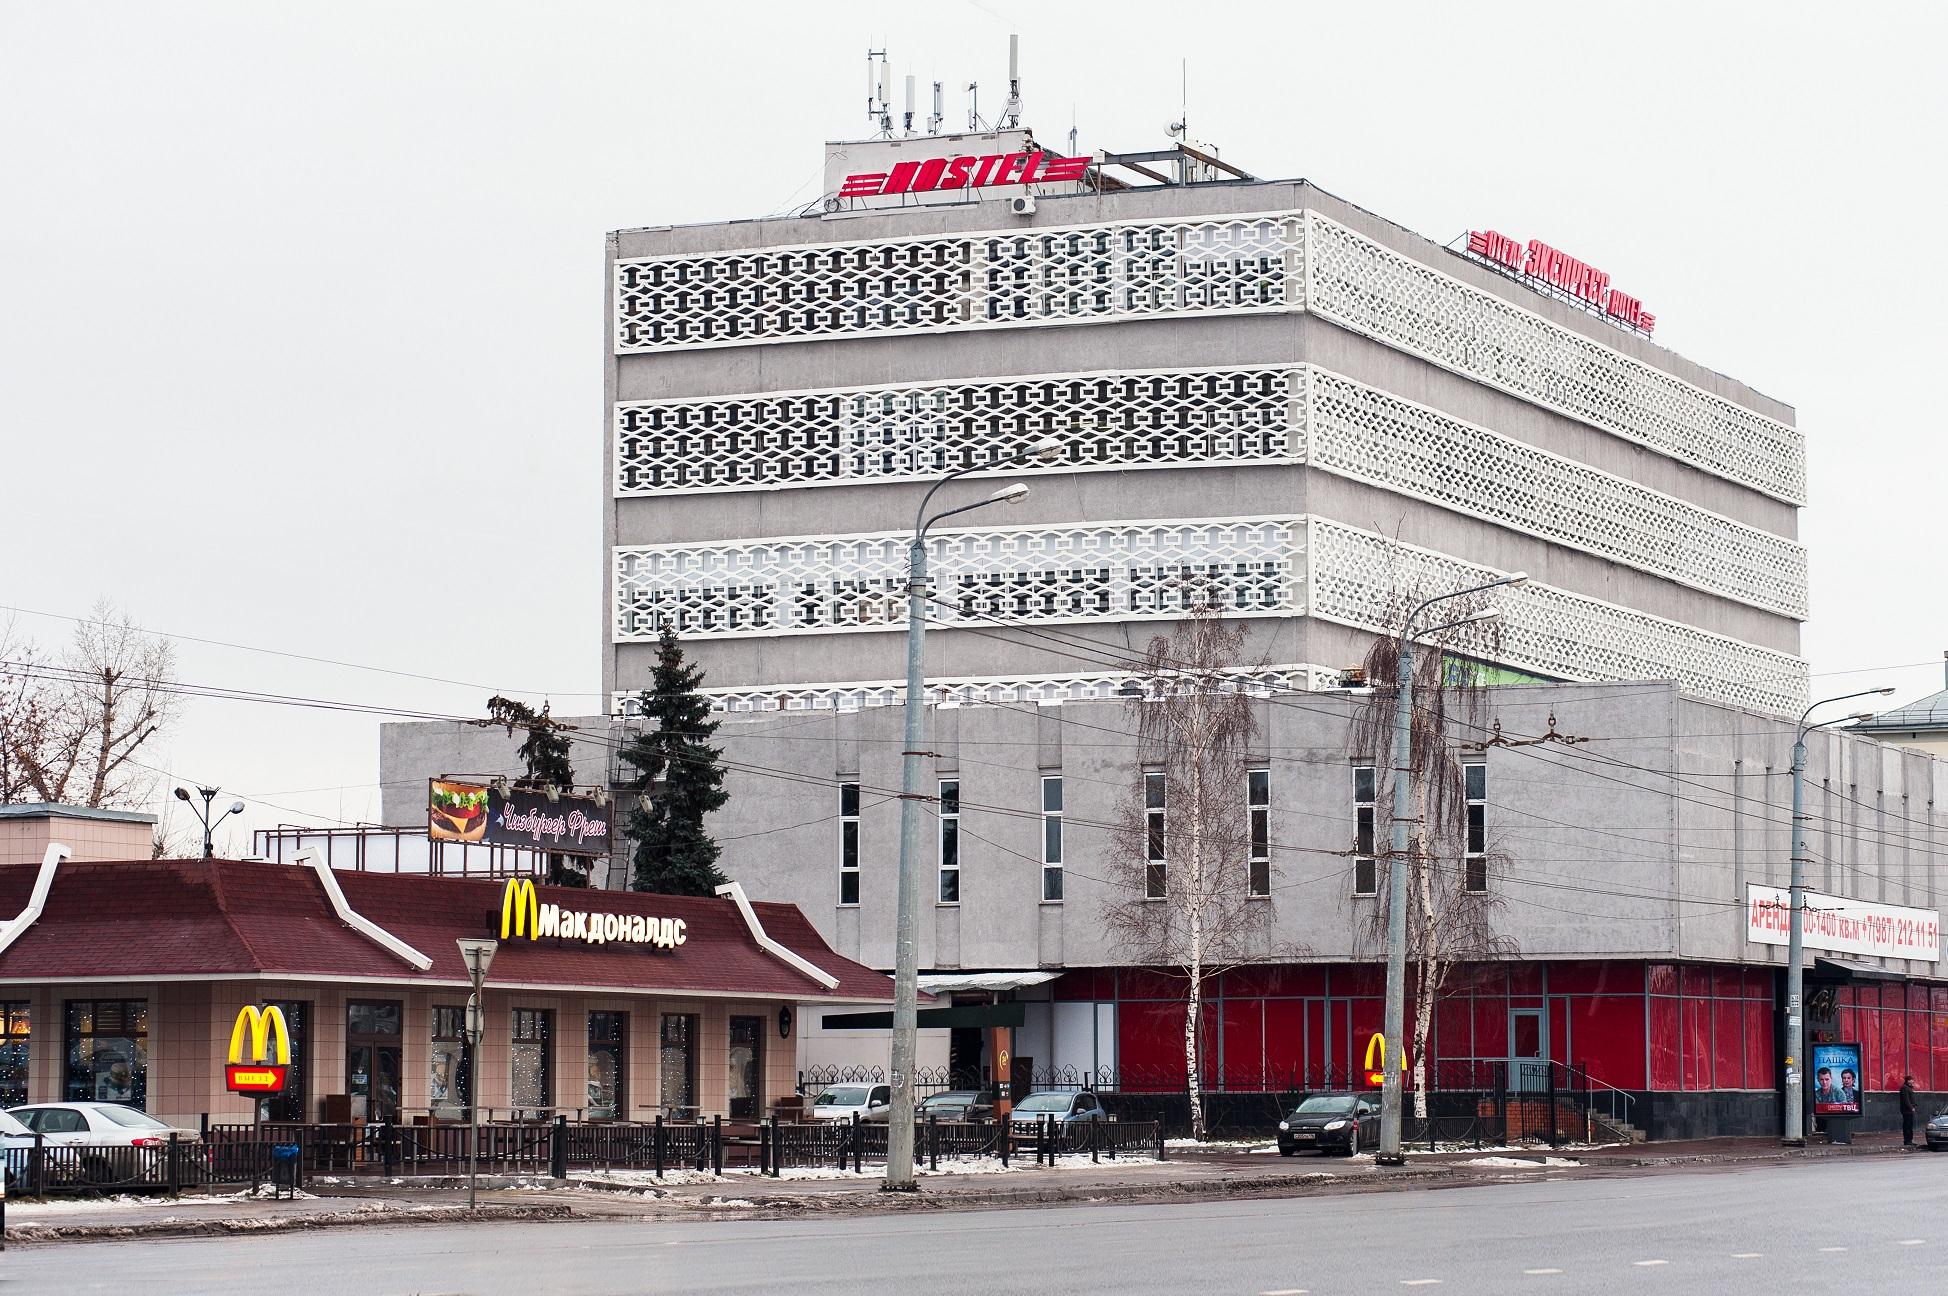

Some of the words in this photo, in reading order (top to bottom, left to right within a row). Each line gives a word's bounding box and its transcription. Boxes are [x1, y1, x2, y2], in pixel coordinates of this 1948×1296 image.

[882, 151, 1045, 194] HOSTEL
[1486, 230, 1524, 271] ОТЕЛЬ
[1524, 239, 1610, 308] ЭКСПРЕСС
[503, 801, 566, 842] Чизбургер
[567, 810, 607, 844] Фреш
[538, 903, 687, 948] Макдоналдс
[1751, 898, 1792, 937] АРЕНД
[1802, 907, 1837, 937] 00-1400
[1897, 918, 1913, 946] 212
[1915, 920, 1925, 948] 11
[1928, 922, 1938, 949] 51
